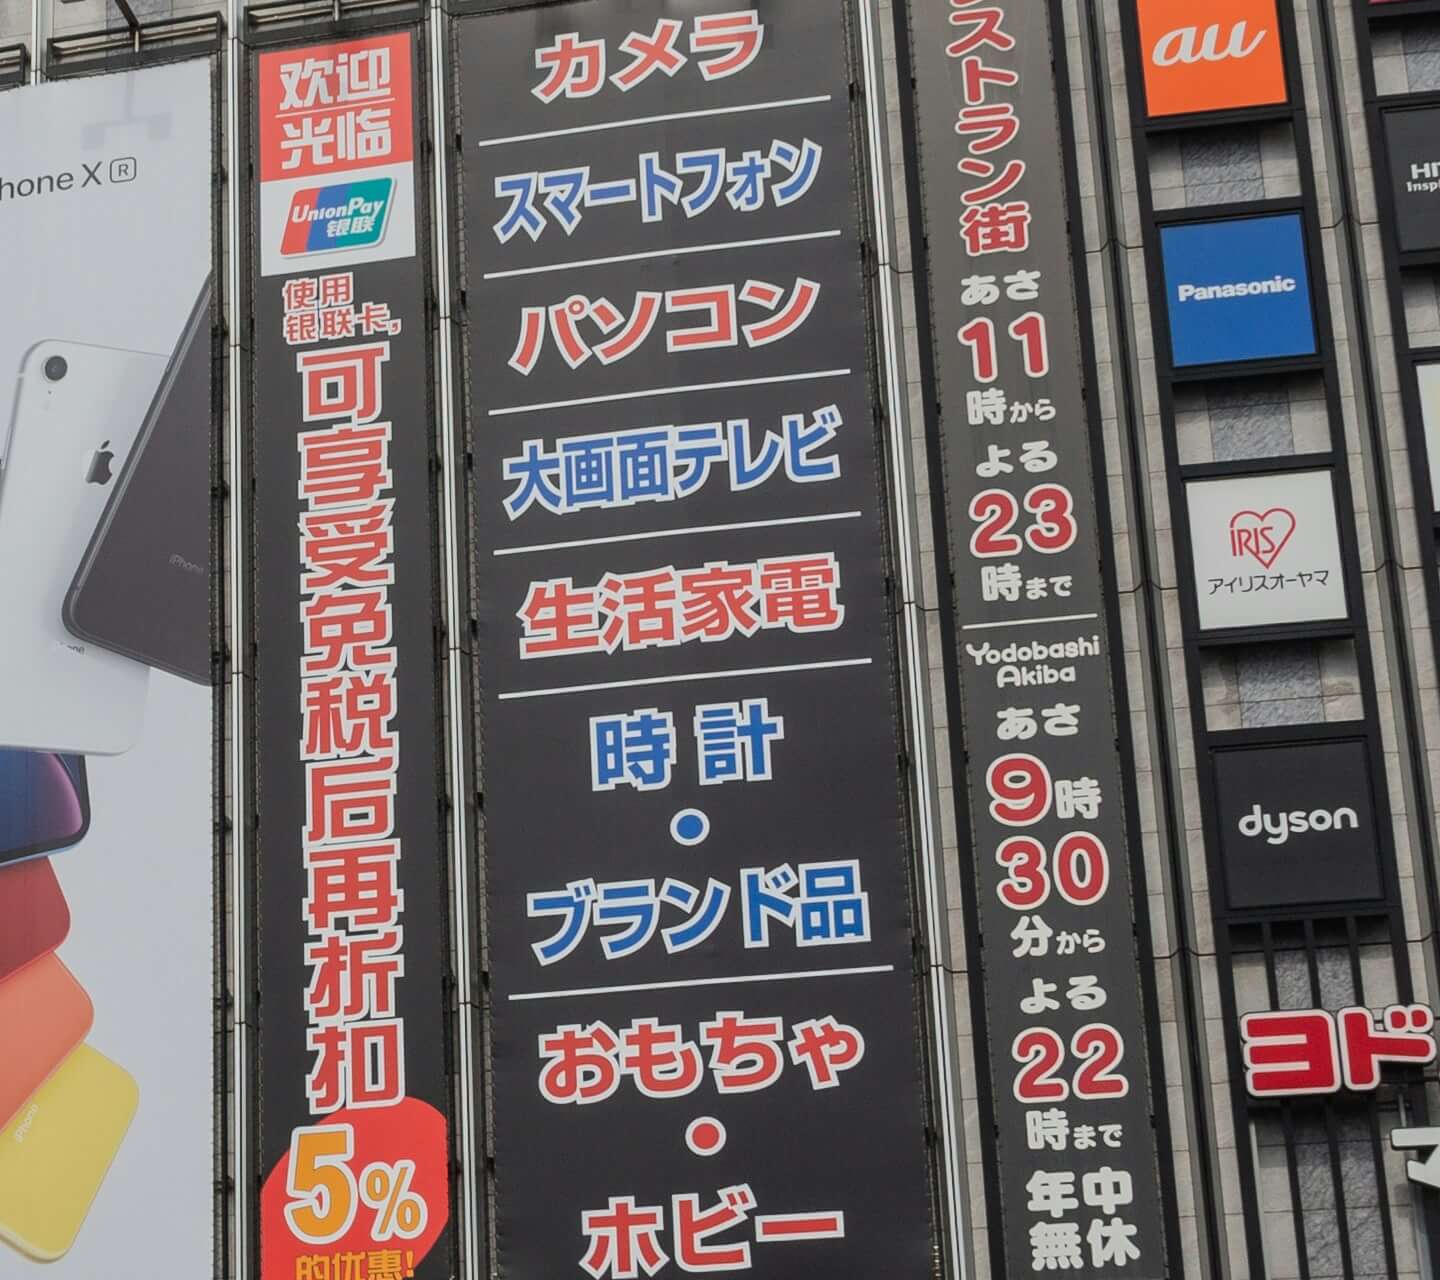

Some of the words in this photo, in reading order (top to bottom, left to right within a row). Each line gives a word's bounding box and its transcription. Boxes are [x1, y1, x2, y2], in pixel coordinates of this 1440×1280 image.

[530, 9, 765, 105] カメラ
[1151, 19, 1268, 67] au
[279, 45, 392, 111] 欢迎
[280, 108, 392, 170] 光临
[291, 194, 385, 225] UnionPay
[492, 137, 824, 245] スマートフォン
[325, 215, 377, 239] 银联
[281, 271, 354, 314] 使用
[959, 269, 1042, 307] あさ
[1177, 274, 1297, 302] Panasonic
[507, 276, 822, 376] パソコン
[957, 310, 1049, 384] 11
[501, 403, 844, 521] 大画面テレビ
[974, 439, 1059, 479] よる
[967, 481, 1078, 559] 23
[515, 550, 846, 660] 生活家電
[1206, 569, 1330, 595] アイリスオーヤマ
[965, 635, 1100, 667] Yodobashi
[995, 662, 1077, 688] Akiba
[296, 340, 406, 1116] 可享受免税后再折扣
[588, 696, 785, 792] 時計
[995, 700, 1082, 741] あさ
[1237, 804, 1360, 845] dyson
[994, 829, 1111, 912] 30
[525, 858, 872, 967] ブランド品
[1018, 974, 1108, 1016] よる
[537, 1009, 866, 1105] おもちゃ
[1010, 1022, 1130, 1104] 22
[283, 1124, 428, 1244] 5%
[1024, 1165, 1134, 1219] 年中
[578, 1182, 845, 1280] ホビー
[1027, 1217, 1141, 1273] 無休
